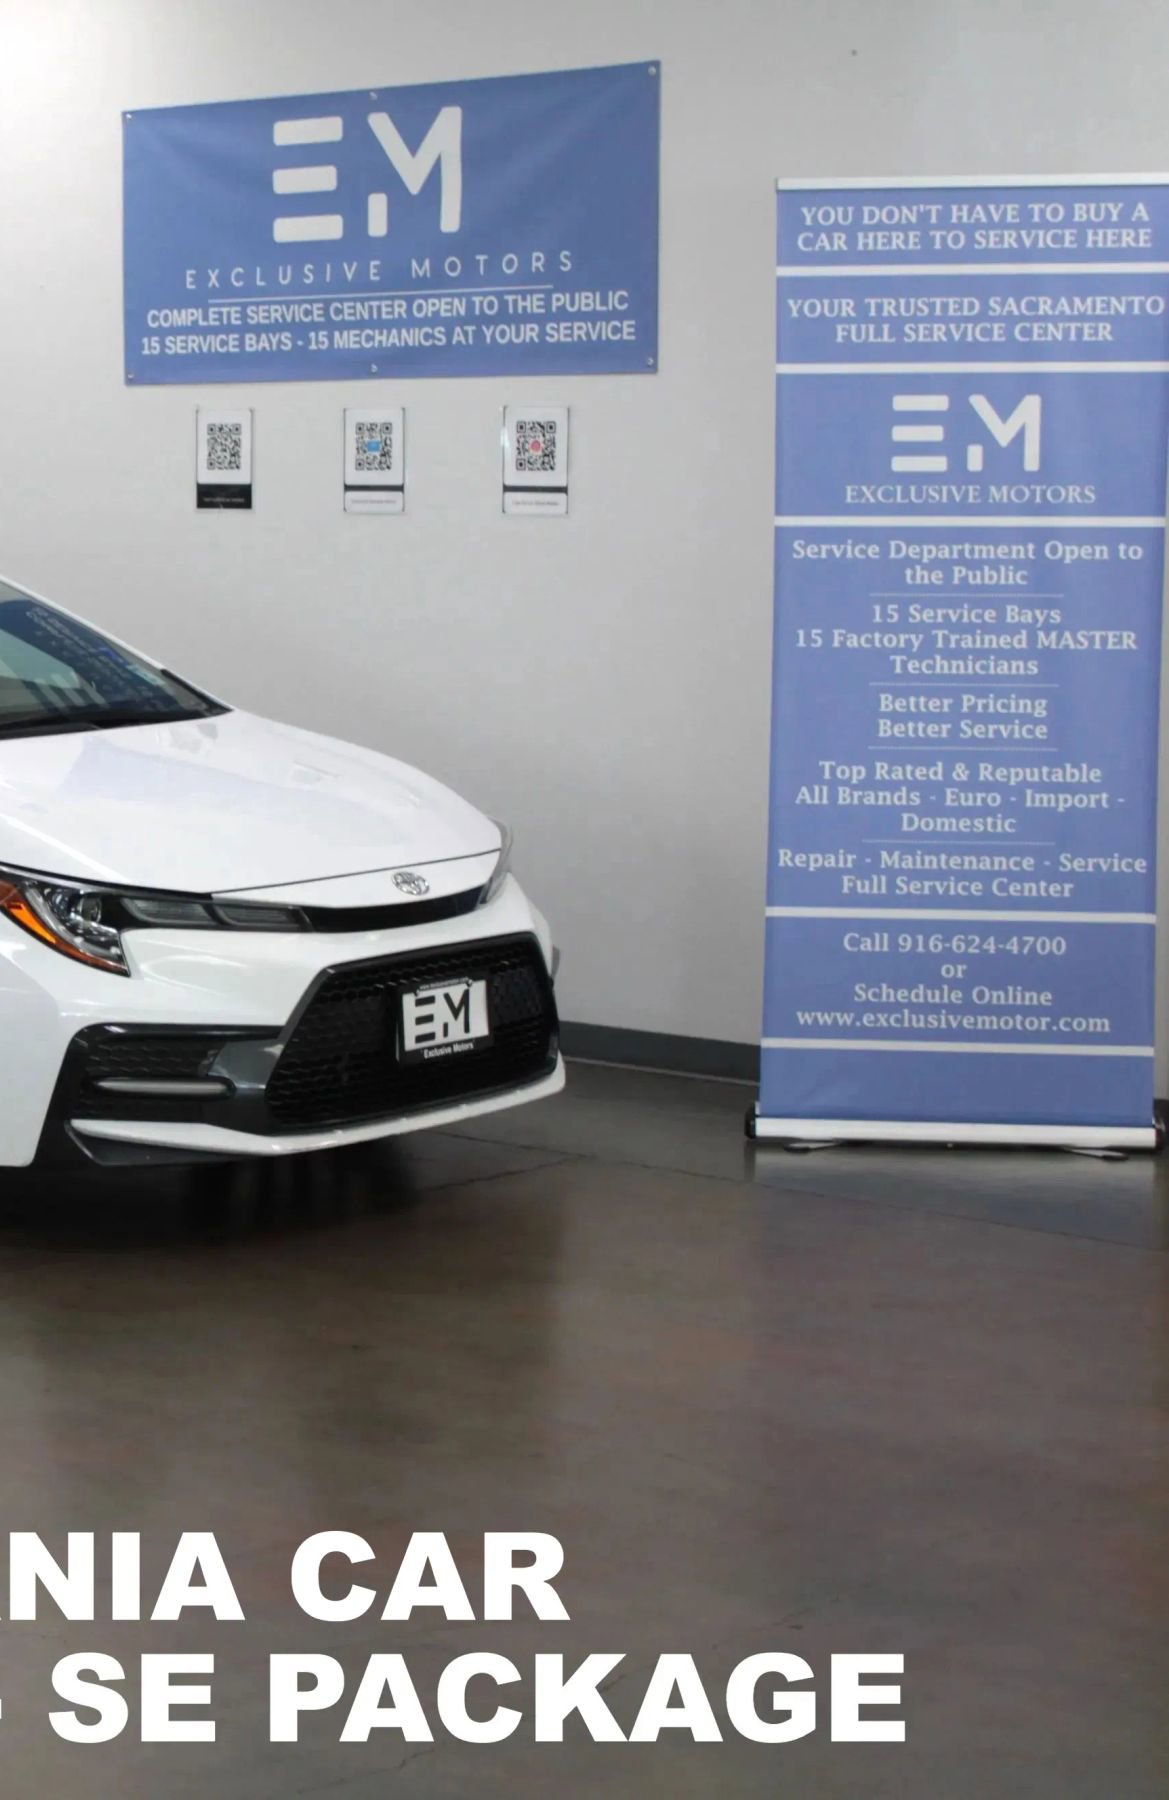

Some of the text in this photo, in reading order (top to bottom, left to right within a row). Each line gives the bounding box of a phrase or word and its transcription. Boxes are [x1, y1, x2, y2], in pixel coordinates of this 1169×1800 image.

[273, 106, 462, 243] EM
[801, 202, 1150, 226] YOU DON'T HAVE TO BUY A
[797, 229, 1152, 251] CAR HERE TO SERVICE HERE
[185, 250, 572, 289] EXCLUSIVE MOTORS
[147, 290, 629, 328] COMPLETE SERVICE CENTER OPEN TO THE PUBLIC
[787, 296, 1165, 318] YOUR TRUSTED SACRAMENTO
[141, 336, 161, 355] 15
[164, 333, 240, 354] SERVICE
[245, 330, 292, 352] BAYS
[308, 330, 329, 350] 15
[333, 326, 447, 350] MECHANICS
[451, 324, 476, 345] AT
[481, 322, 539, 344] YOUR
[545, 319, 636, 343] SERVICE
[835, 323, 1113, 343] FULL SERVICE CENTER
[891, 394, 1041, 472] EM
[845, 485, 1096, 504] EXCLUSIVE MOTORS
[792, 540, 1143, 564] Service Department Open to
[904, 566, 1028, 586] the Public
[872, 604, 1062, 627] 15 Service Bays
[796, 629, 1138, 652] 15 Factory Trained MASTER
[890, 655, 1039, 675] Technicians
[879, 694, 1048, 718] Better Pricing
[878, 720, 1048, 739] Better Service
[819, 761, 1102, 786] Top Rated & Reputable
[795, 786, 829, 805] All
[837, 786, 921, 806] Brands
[944, 788, 1002, 807] Euro
[1025, 789, 1109, 812] Import
[901, 813, 1017, 833] Domestic
[778, 849, 857, 872] Repair
[880, 851, 1035, 872] Maintenance
[1059, 853, 1147, 873] Service
[841, 875, 1074, 898] Full Service Center
[843, 933, 1067, 955] Call 916-624-4700
[941, 962, 968, 979] or
[854, 983, 1052, 1005] Schedule Online
[796, 1009, 1111, 1032] www.exclusivemotor.com
